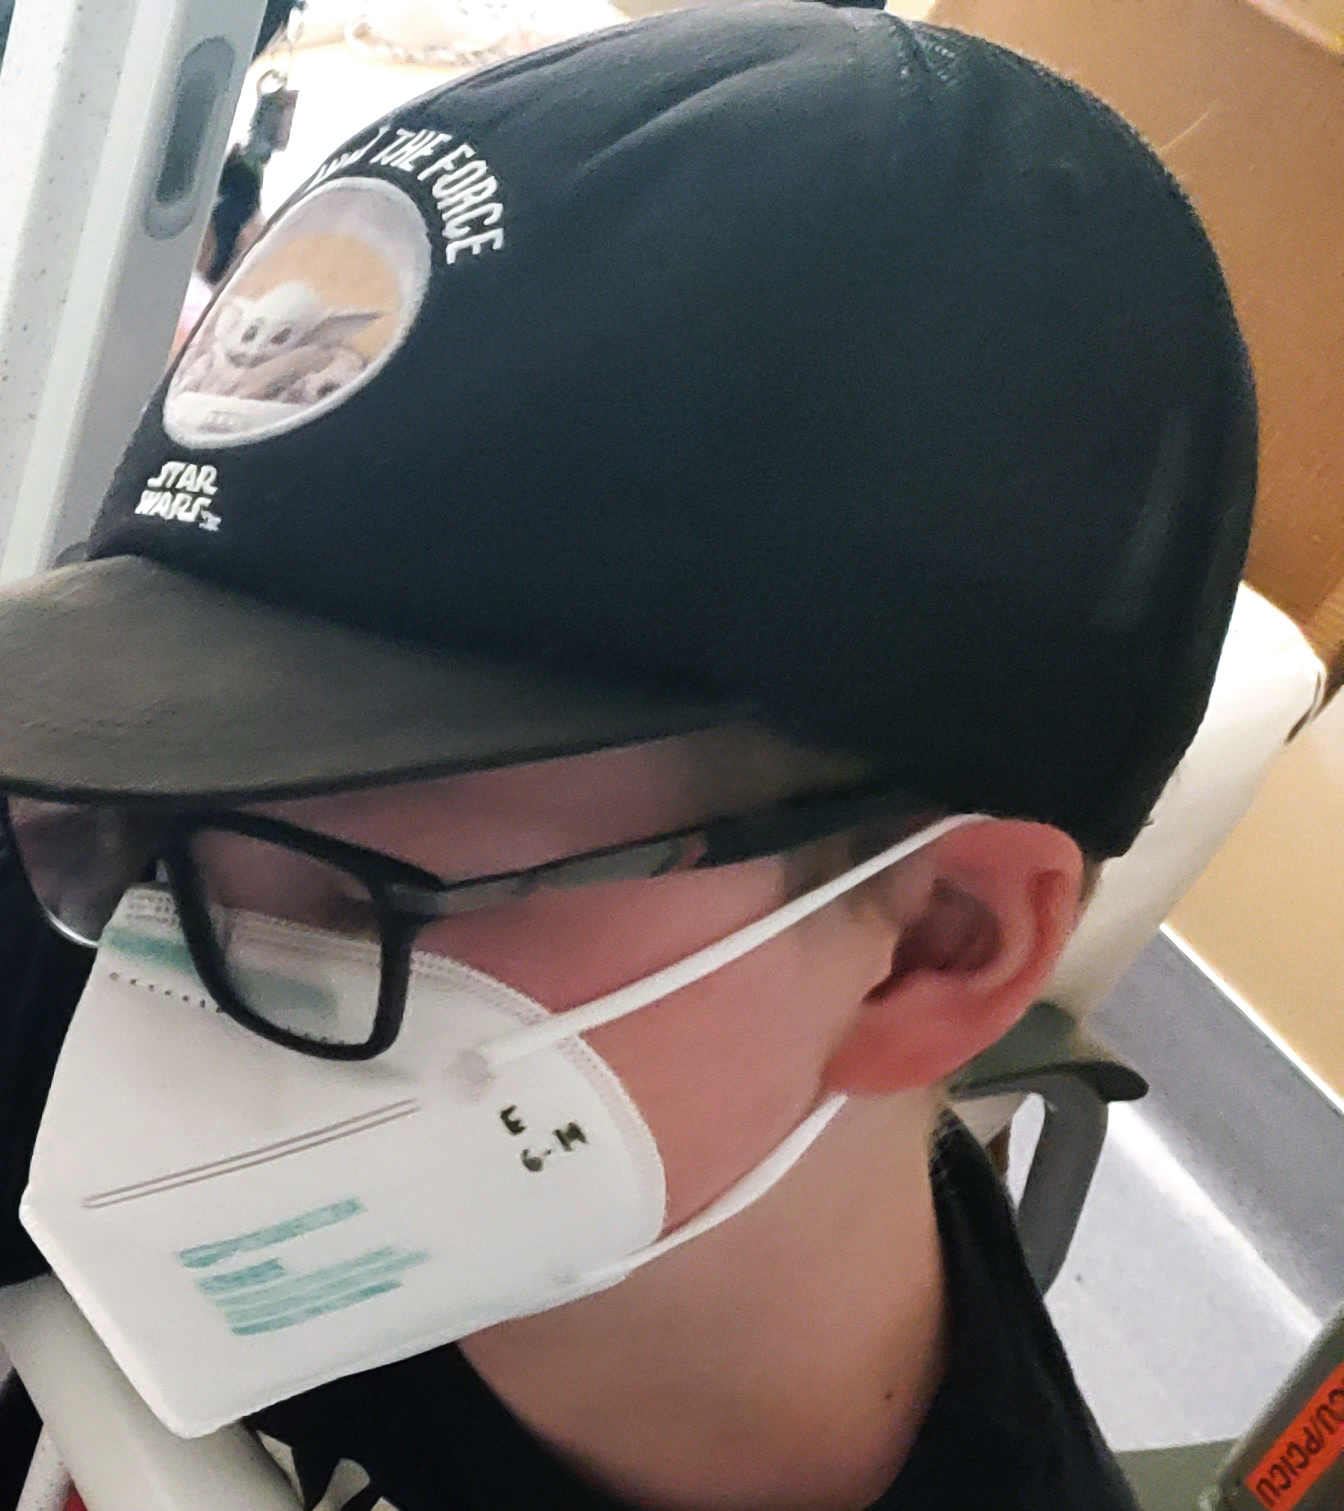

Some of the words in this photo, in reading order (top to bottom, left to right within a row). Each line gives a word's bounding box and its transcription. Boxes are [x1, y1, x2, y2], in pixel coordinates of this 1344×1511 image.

[369, 128, 452, 171] THE
[417, 143, 505, 265] FORCE
[134, 489, 213, 523] WARS
[147, 461, 218, 495] STAR
[1255, 1380, 1344, 1508] CU/PCICU
